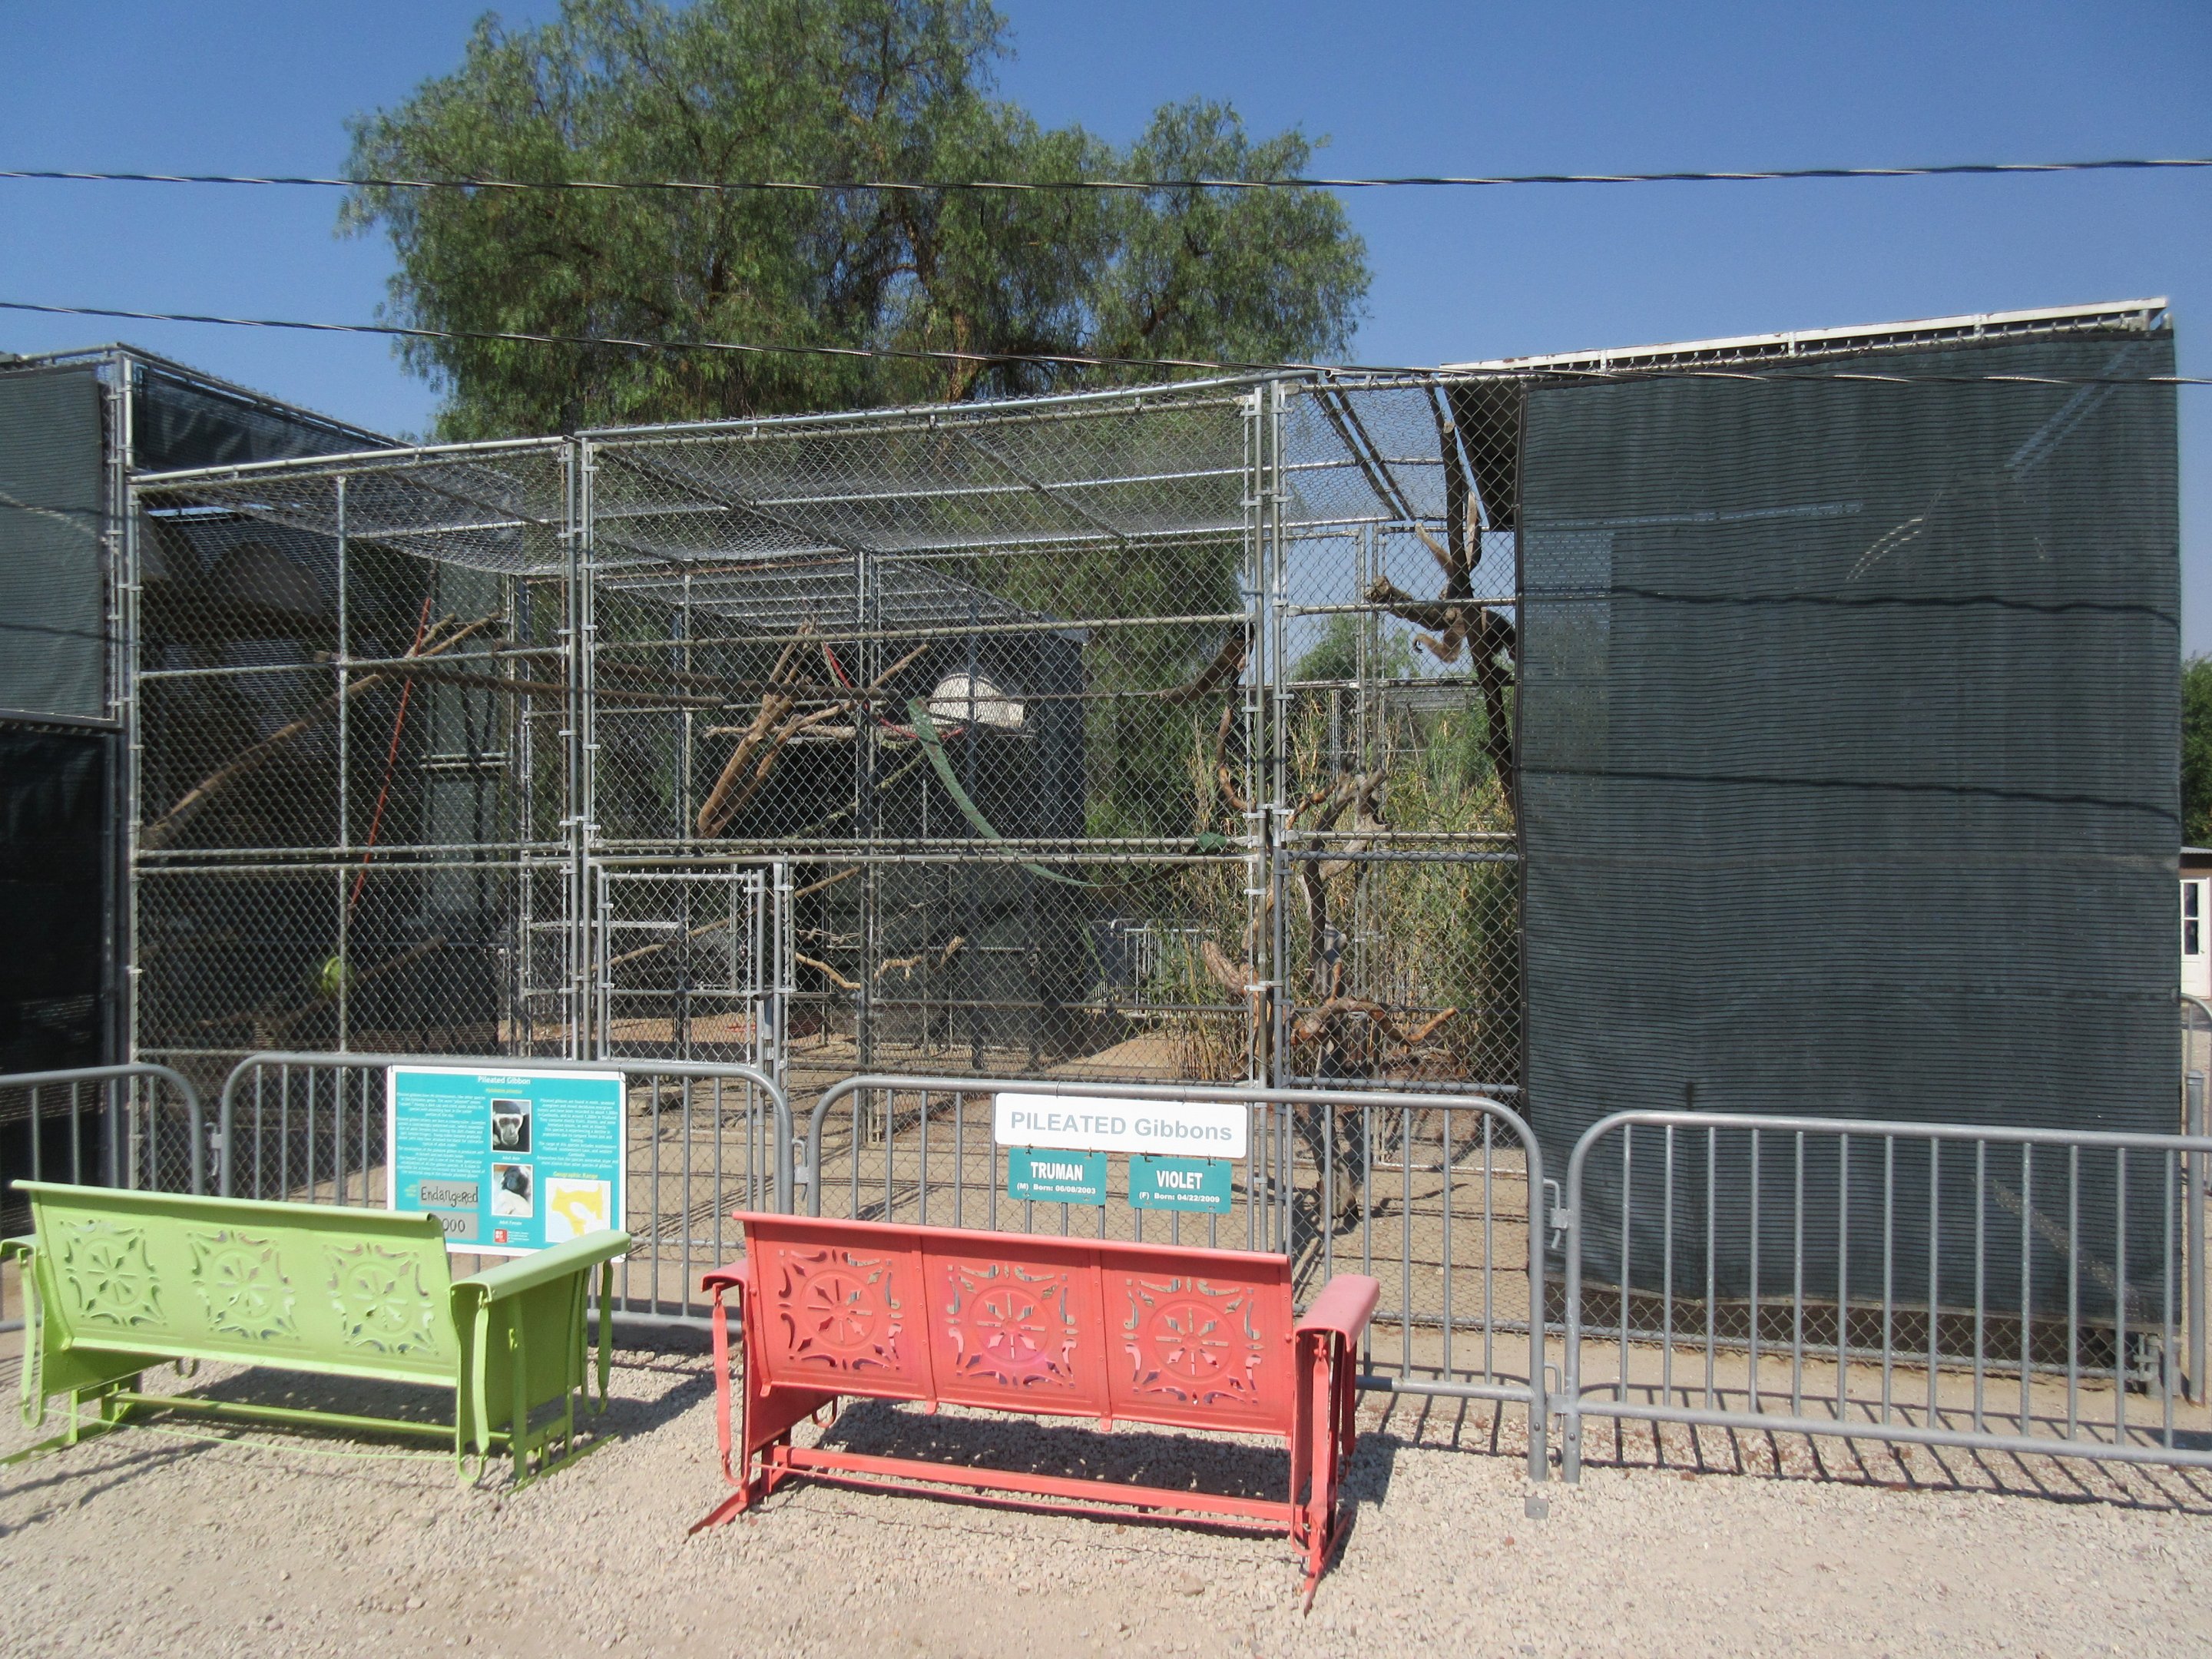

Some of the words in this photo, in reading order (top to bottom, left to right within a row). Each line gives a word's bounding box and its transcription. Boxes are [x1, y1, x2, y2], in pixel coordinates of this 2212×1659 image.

[478, 1075, 505, 1084] Pileated
[1011, 1111, 1126, 1135] PILEATED
[1134, 1118, 1232, 1141] Gibbons
[1030, 1161, 1083, 1181] TRUMAN
[1017, 1182, 1029, 1190] (M)
[1055, 1185, 1096, 1194] 06/08/2003
[1156, 1170, 1203, 1190] VIOLET
[1139, 1191, 1150, 1200] (F)
[1154, 1192, 1175, 1200] Born:
[1177, 1194, 1220, 1203] 04/22/2009
